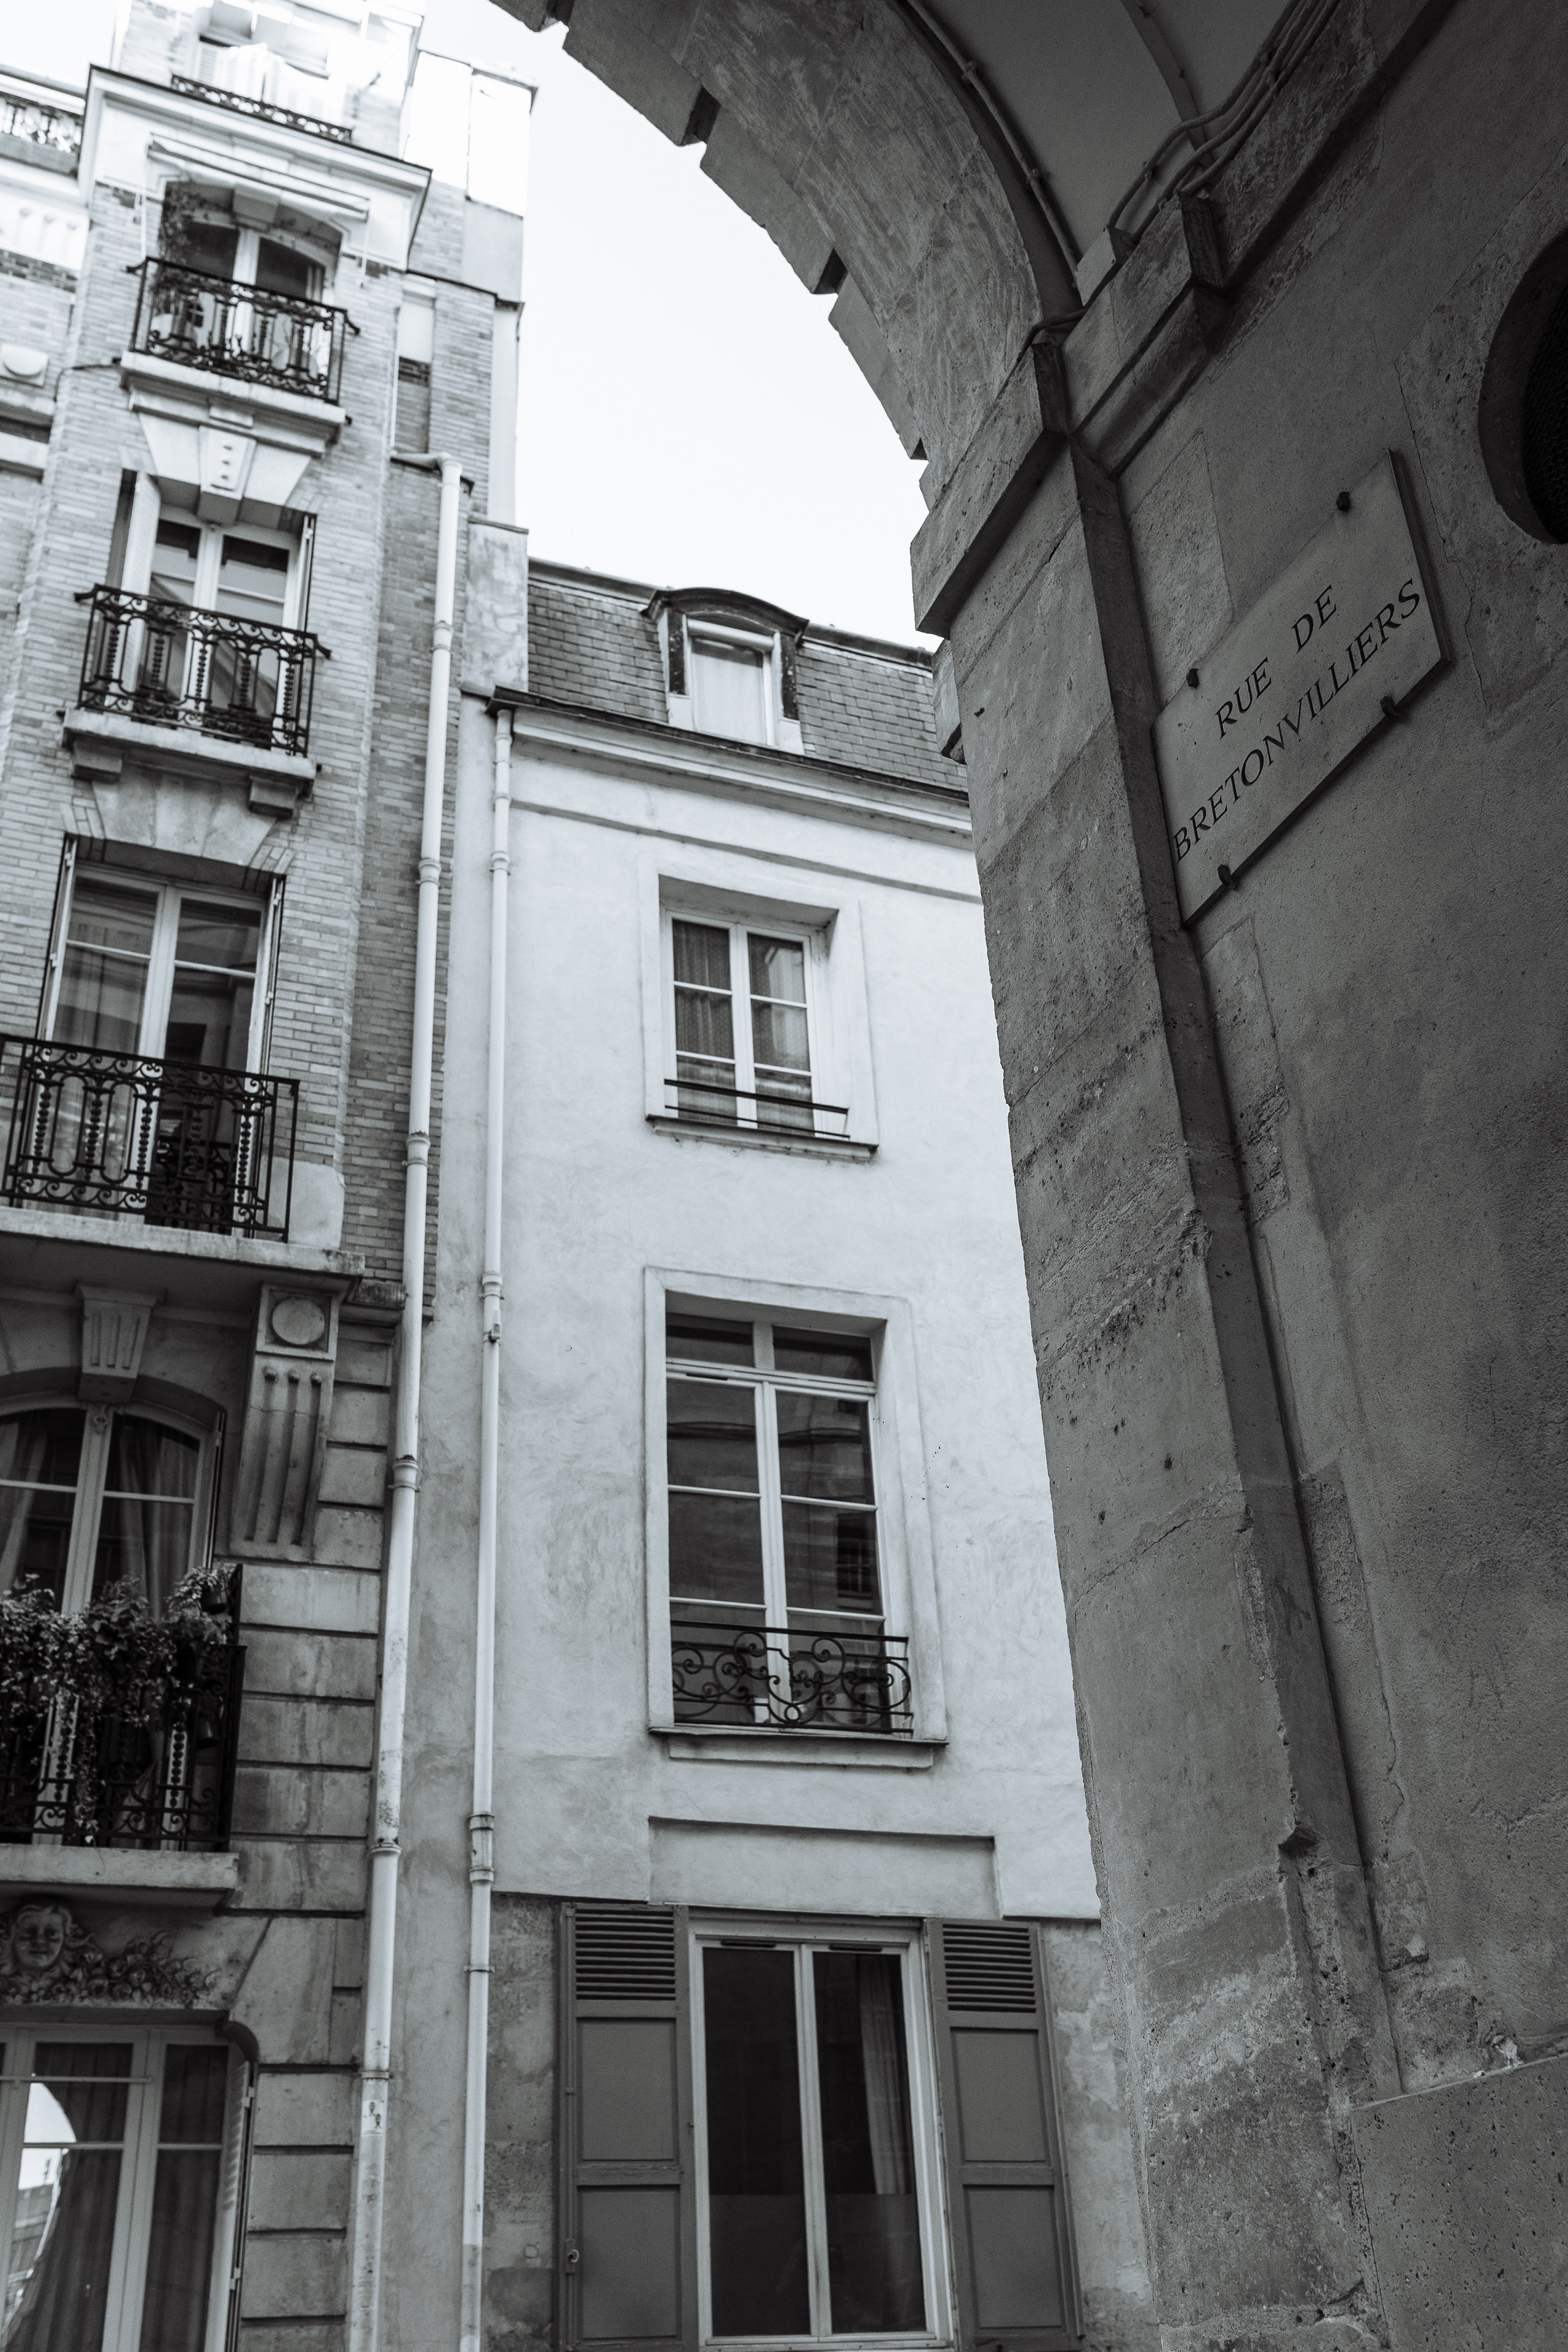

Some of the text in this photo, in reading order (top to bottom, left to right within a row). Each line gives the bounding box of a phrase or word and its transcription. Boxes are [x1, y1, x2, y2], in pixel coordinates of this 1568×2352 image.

[1172, 578, 1421, 864] BRETONVILLIERS
[1215, 584, 1337, 740] RUE DE
